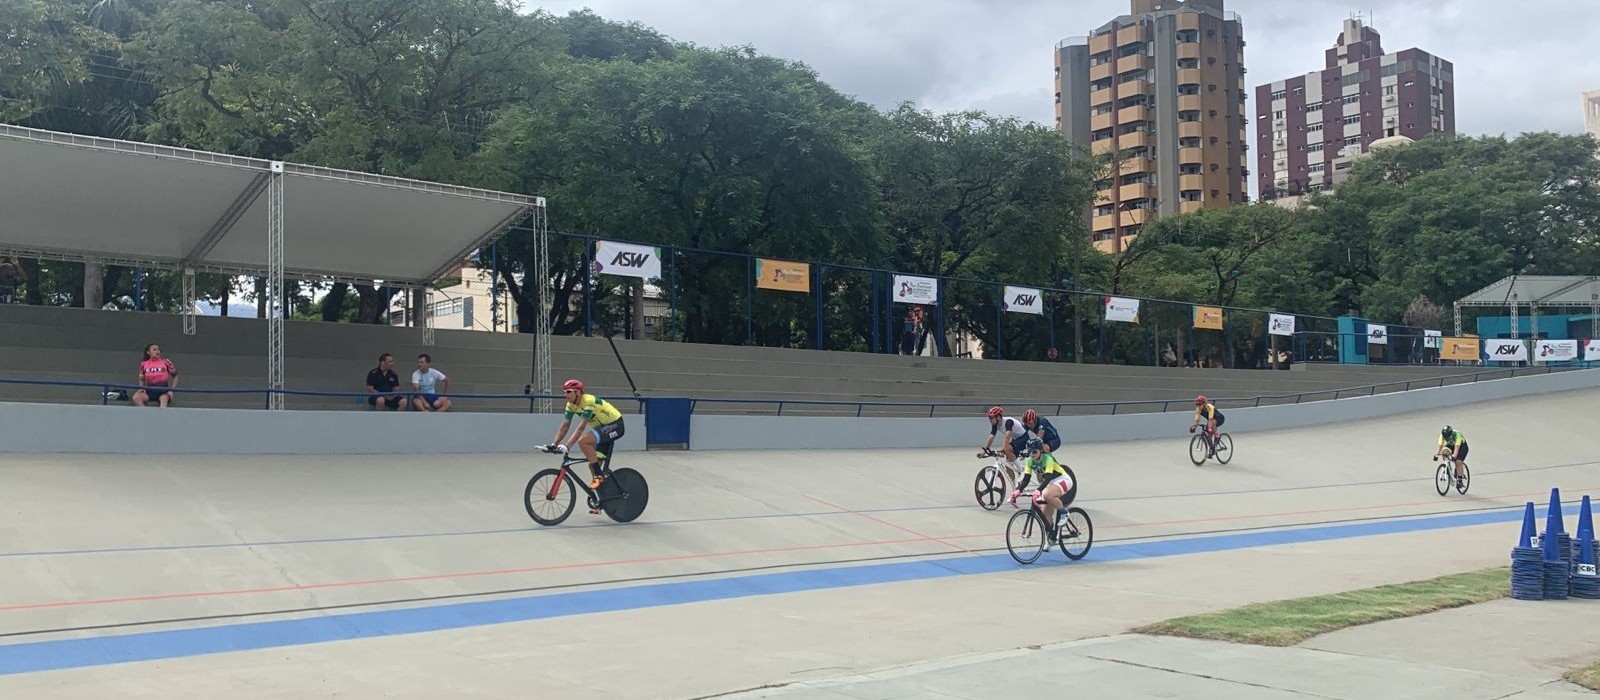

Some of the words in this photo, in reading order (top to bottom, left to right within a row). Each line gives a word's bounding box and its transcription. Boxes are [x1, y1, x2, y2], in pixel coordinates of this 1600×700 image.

[611, 251, 649, 268] ASW
[1013, 293, 1037, 306] ASW
[1495, 344, 1519, 354] ASW
